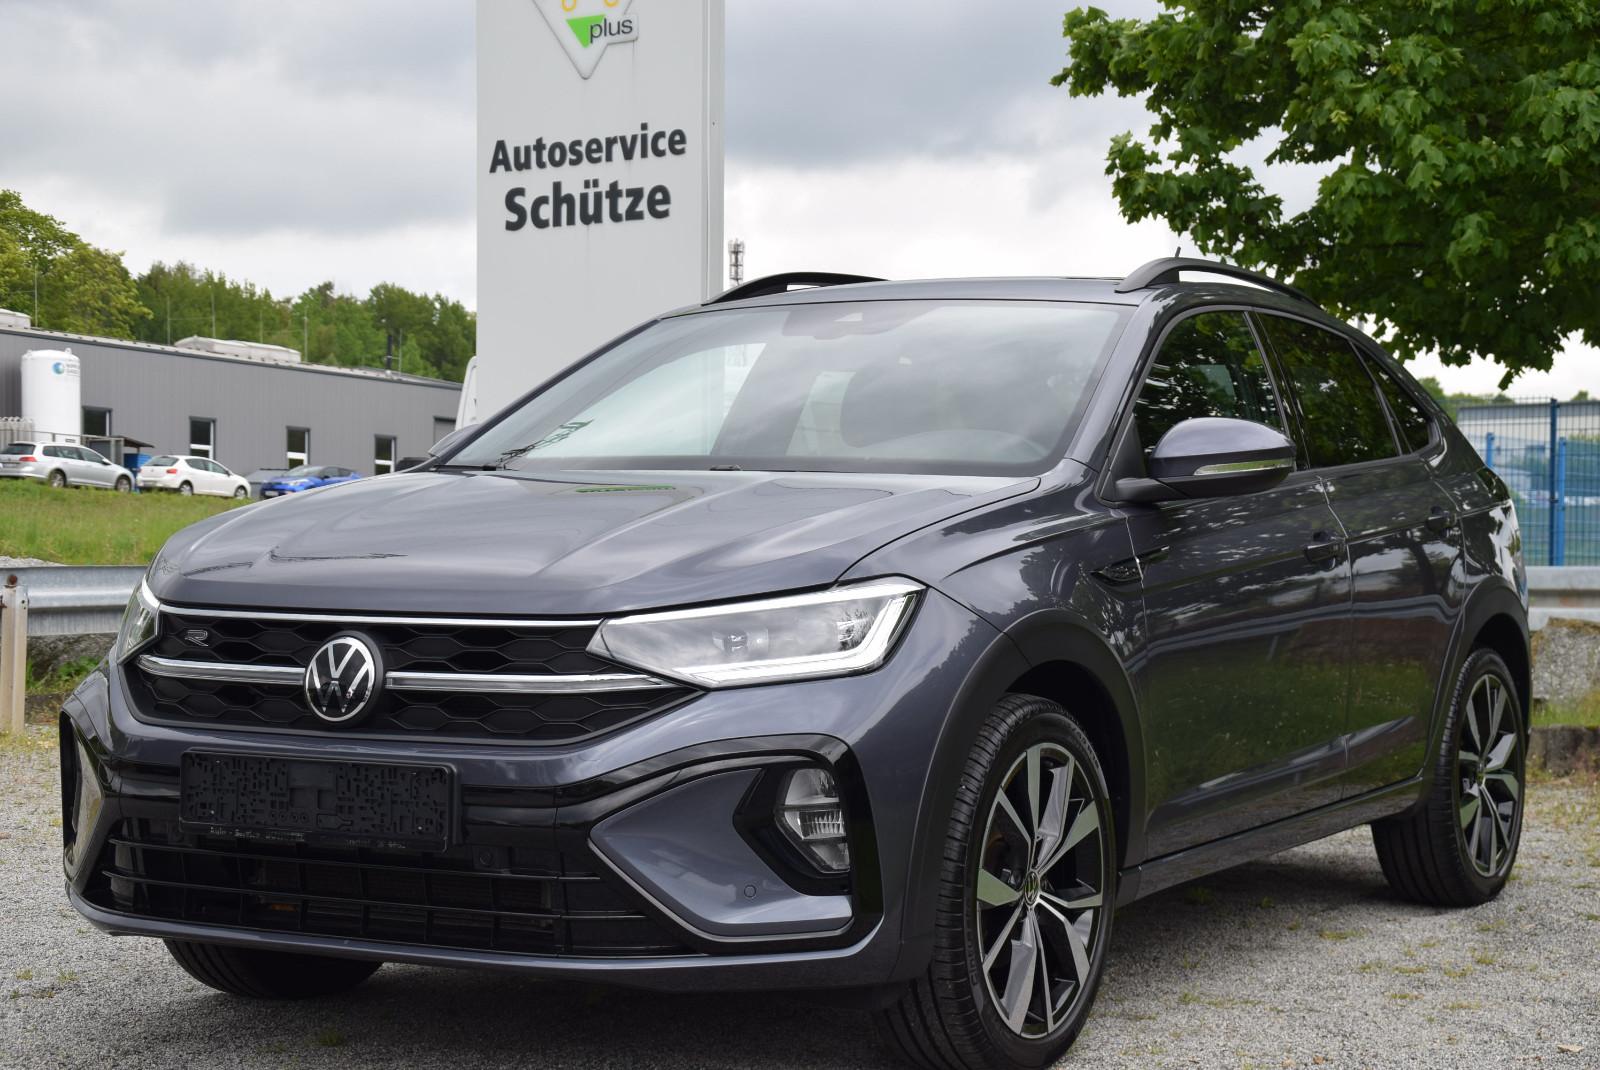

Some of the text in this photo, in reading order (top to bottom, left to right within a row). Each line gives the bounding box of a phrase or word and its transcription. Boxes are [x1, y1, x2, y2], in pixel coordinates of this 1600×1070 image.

[590, 18, 633, 43] plus
[489, 122, 687, 174] Autoservice
[504, 178, 672, 231] Schütze
